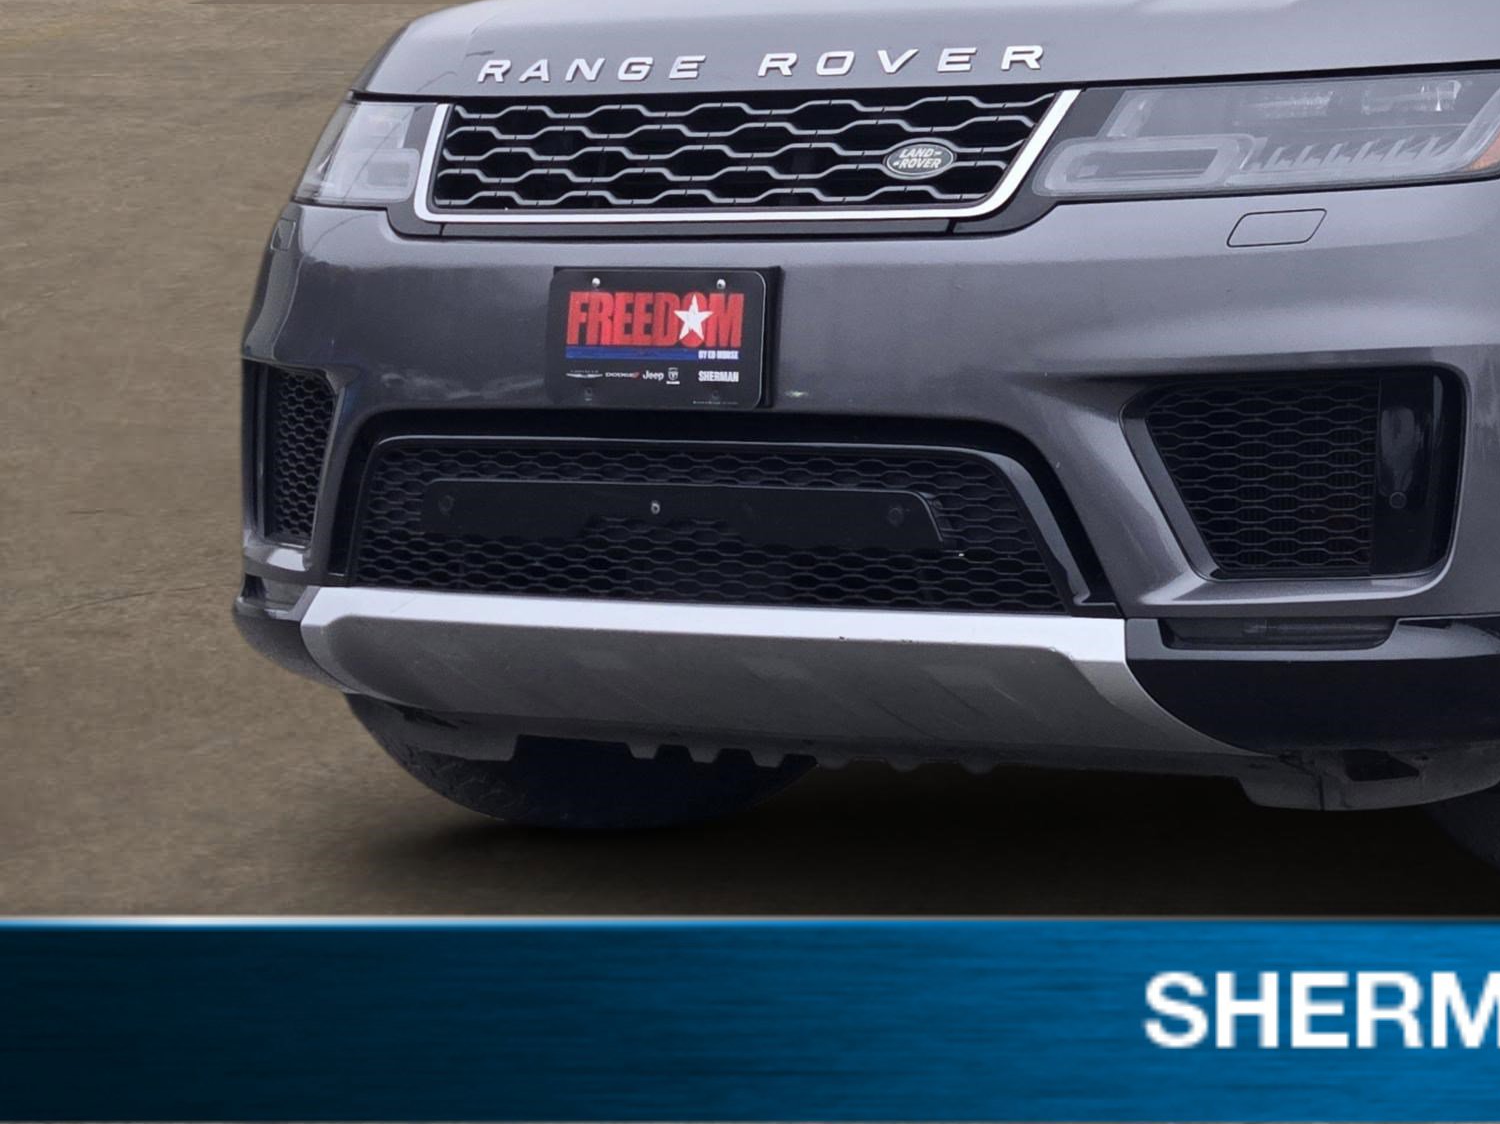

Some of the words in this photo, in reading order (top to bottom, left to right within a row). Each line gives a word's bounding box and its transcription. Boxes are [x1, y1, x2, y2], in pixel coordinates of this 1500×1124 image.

[476, 54, 707, 84] RANGE
[756, 44, 1045, 78] ROVER
[898, 147, 935, 158] LAND
[898, 158, 942, 169] ROVER
[566, 291, 744, 348] FREEDOM
[642, 369, 665, 382] Jeep
[697, 369, 740, 383] SHERMAN
